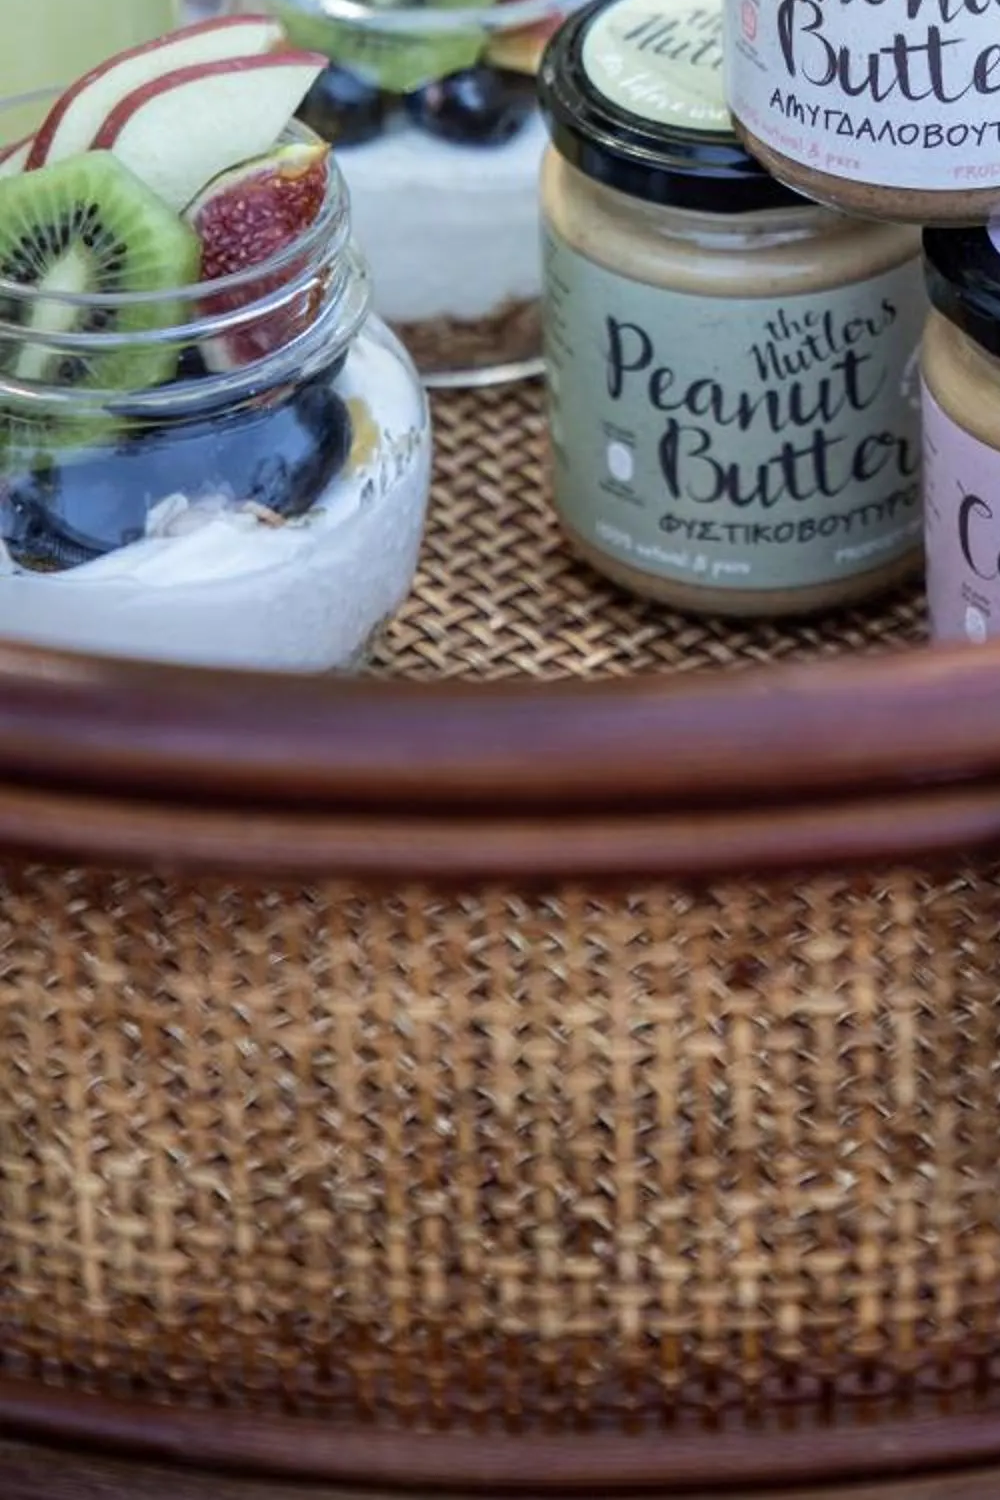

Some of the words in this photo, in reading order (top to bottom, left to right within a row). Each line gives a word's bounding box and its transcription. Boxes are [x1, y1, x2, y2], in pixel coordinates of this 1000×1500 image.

[751, 299, 897, 382] Nutlers
[764, 307, 820, 341] the
[606, 314, 888, 433] Peanut
[658, 418, 922, 508] Butter
